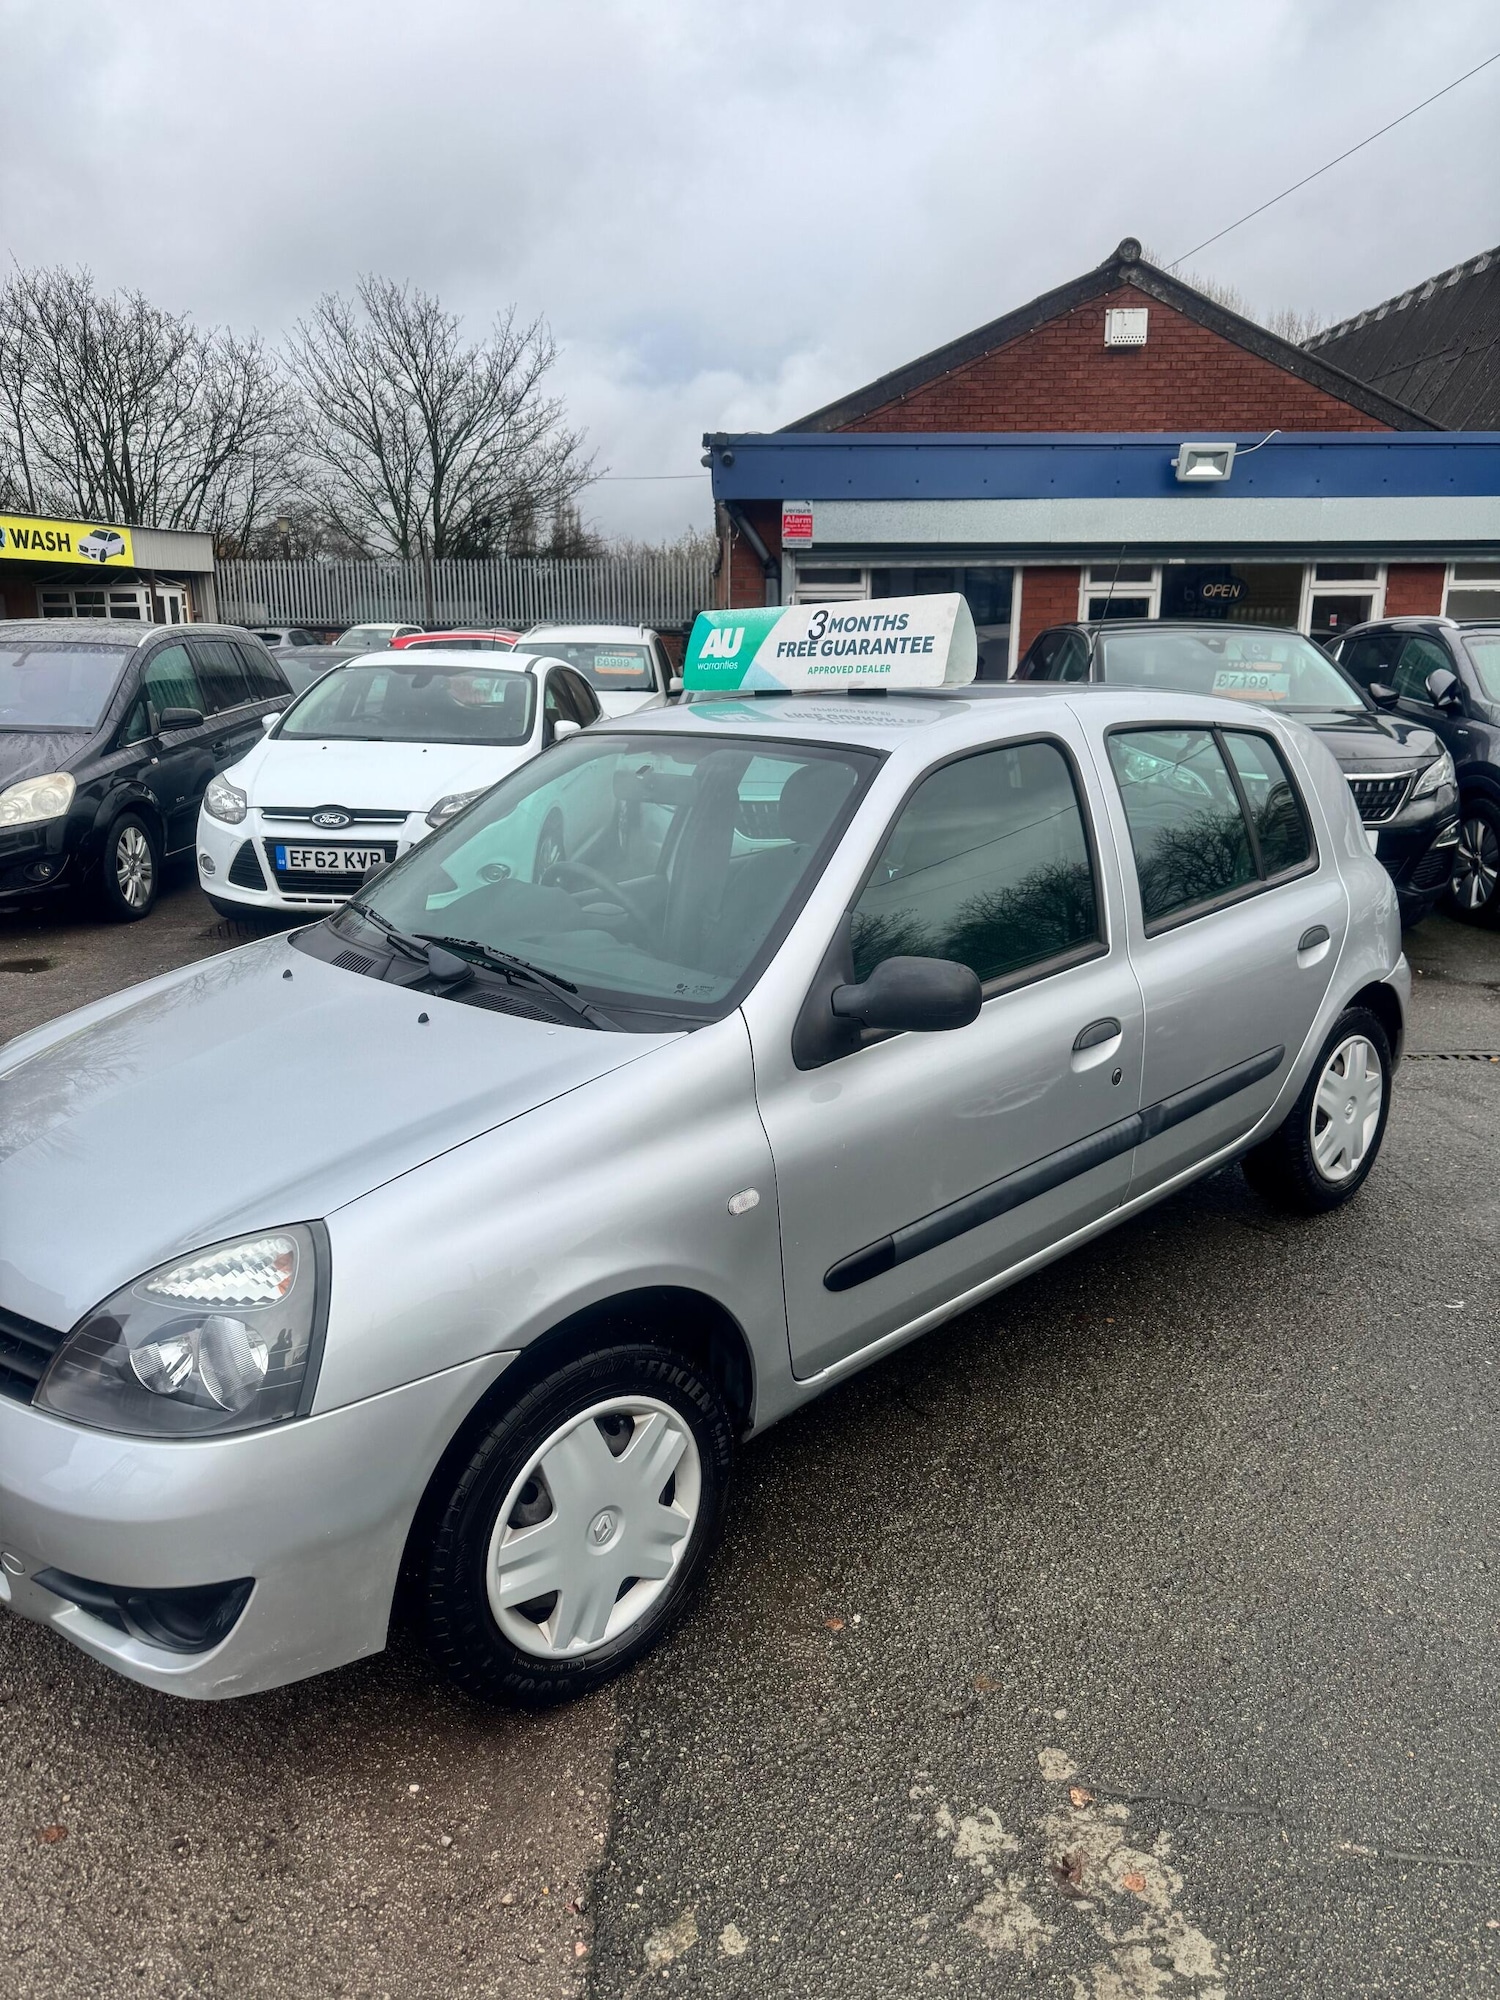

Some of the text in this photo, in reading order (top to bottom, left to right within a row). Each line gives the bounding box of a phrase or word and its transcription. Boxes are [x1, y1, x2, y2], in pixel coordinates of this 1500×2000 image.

[785, 516, 811, 524] Alarm
[9, 528, 71, 552] WASH
[1203, 584, 1240, 597] OPEN
[808, 610, 910, 641] 3 MONTHS
[699, 627, 745, 659] AU
[777, 636, 935, 658] FREE GUARANTEE
[596, 657, 630, 667] £6999
[697, 660, 738, 670] warranties
[808, 664, 891, 675] APPROVED DEALER
[1216, 673, 1268, 688] £7199
[320, 814, 340, 824] Ford
[290, 850, 339, 868] EF62
